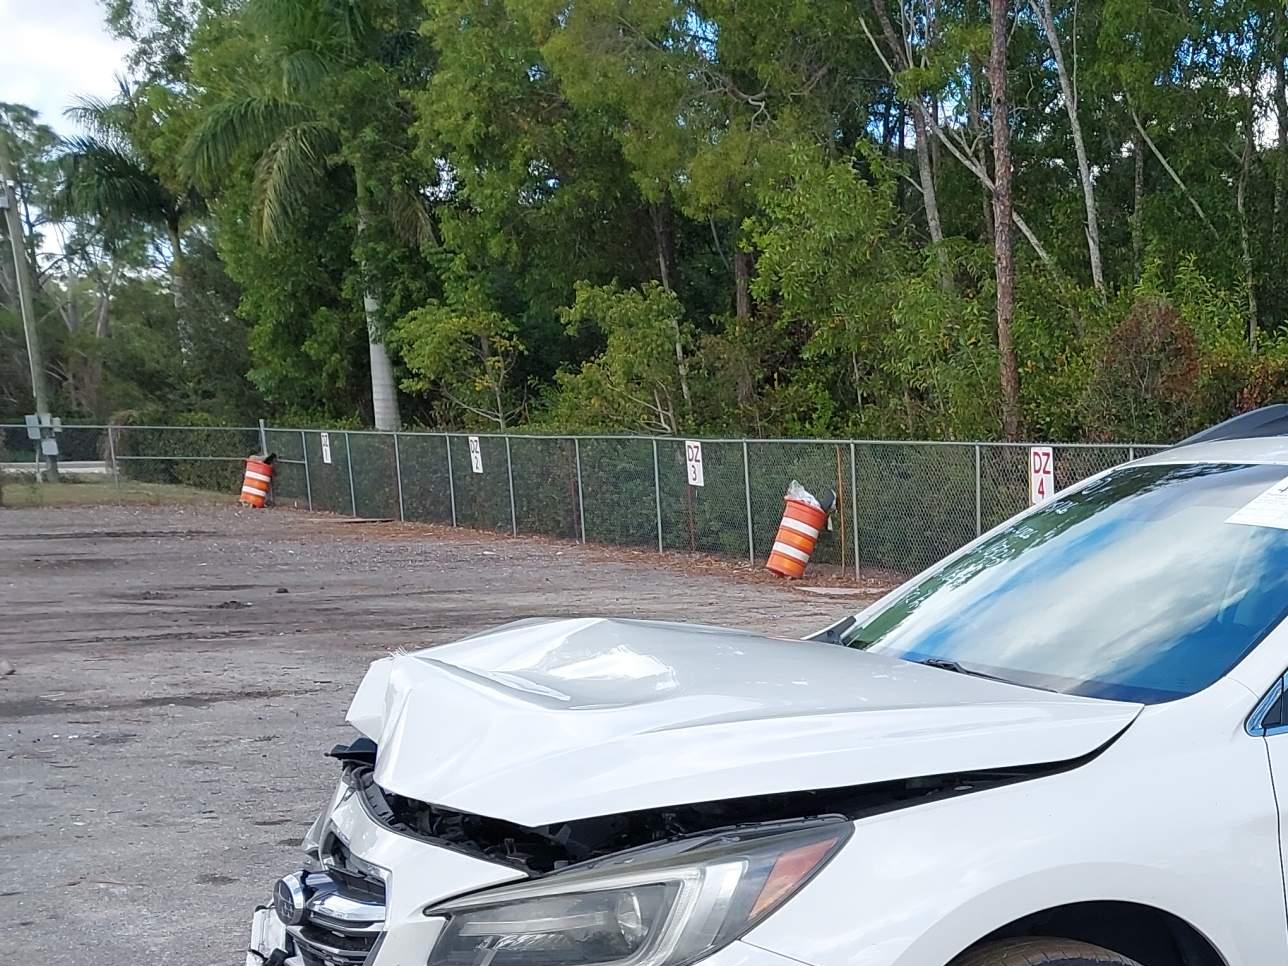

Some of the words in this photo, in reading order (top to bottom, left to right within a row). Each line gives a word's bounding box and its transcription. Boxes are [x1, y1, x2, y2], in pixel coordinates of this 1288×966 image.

[469, 439, 480, 454] DZ
[687, 445, 701, 463] DZ
[473, 455, 480, 470] 2
[1032, 451, 1051, 475] DZ
[691, 465, 698, 482] 3
[1037, 477, 1045, 499] 4
